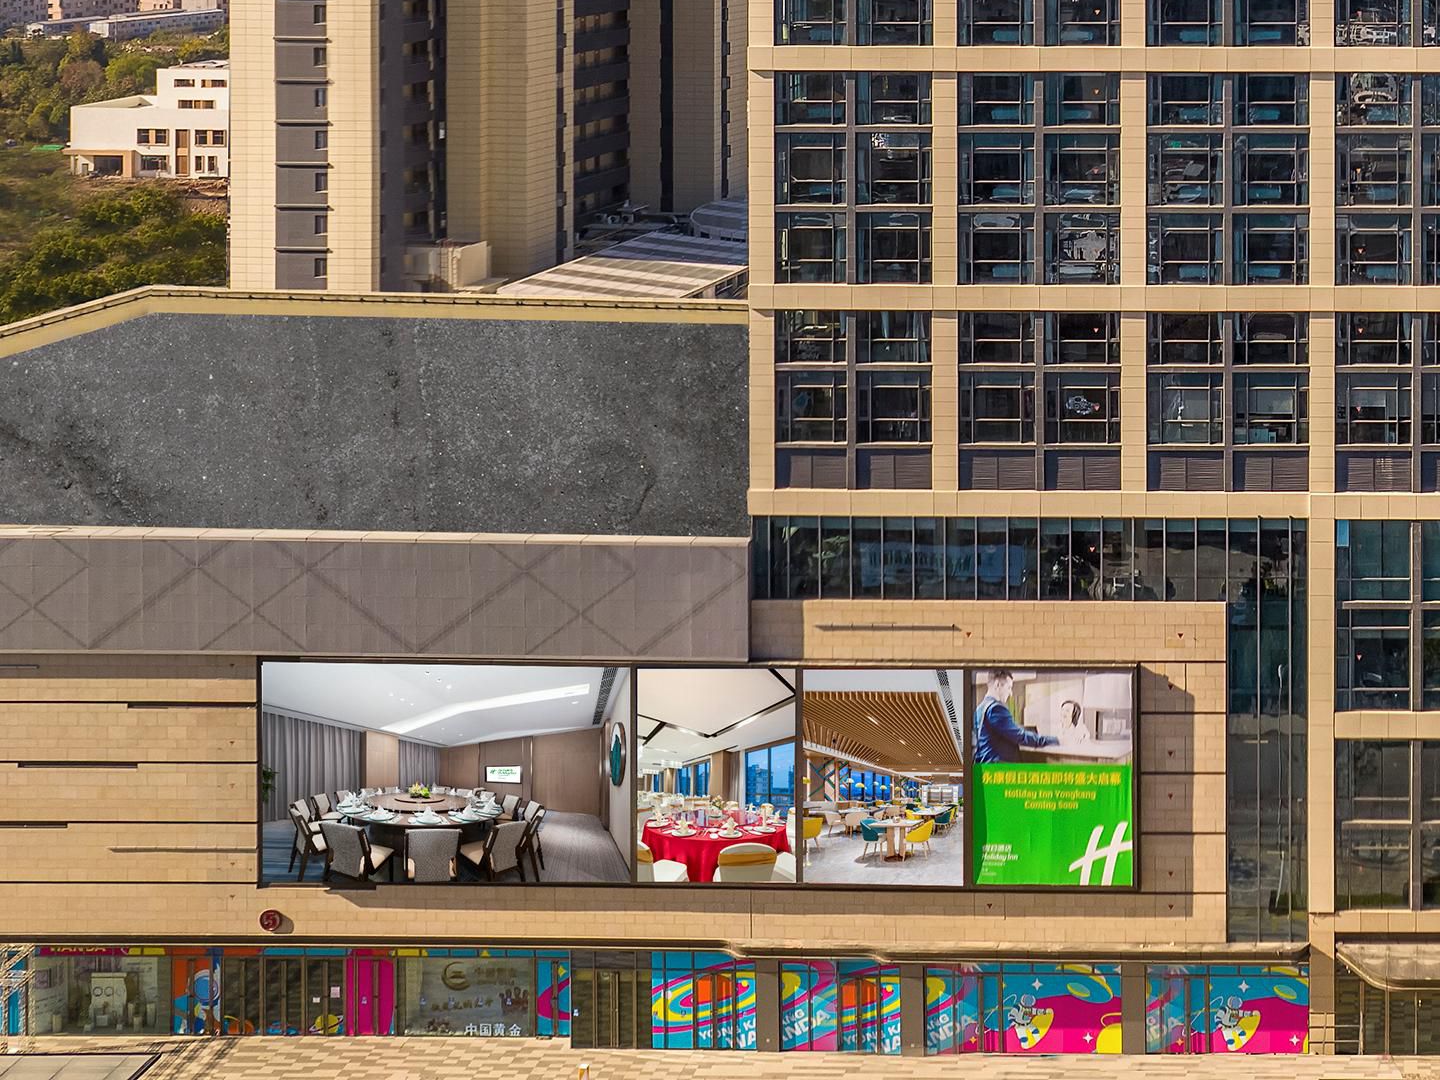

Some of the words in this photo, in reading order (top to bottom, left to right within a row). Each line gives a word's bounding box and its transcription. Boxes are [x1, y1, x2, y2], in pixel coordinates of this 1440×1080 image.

[1004, 788, 1037, 799] Holiday
[1038, 789, 1053, 798] Inn
[1055, 789, 1096, 800] Yongkang
[1024, 800, 1056, 811] Coming
[1058, 800, 1079, 809] Soon
[464, 1023, 522, 1036] 中国黄金
